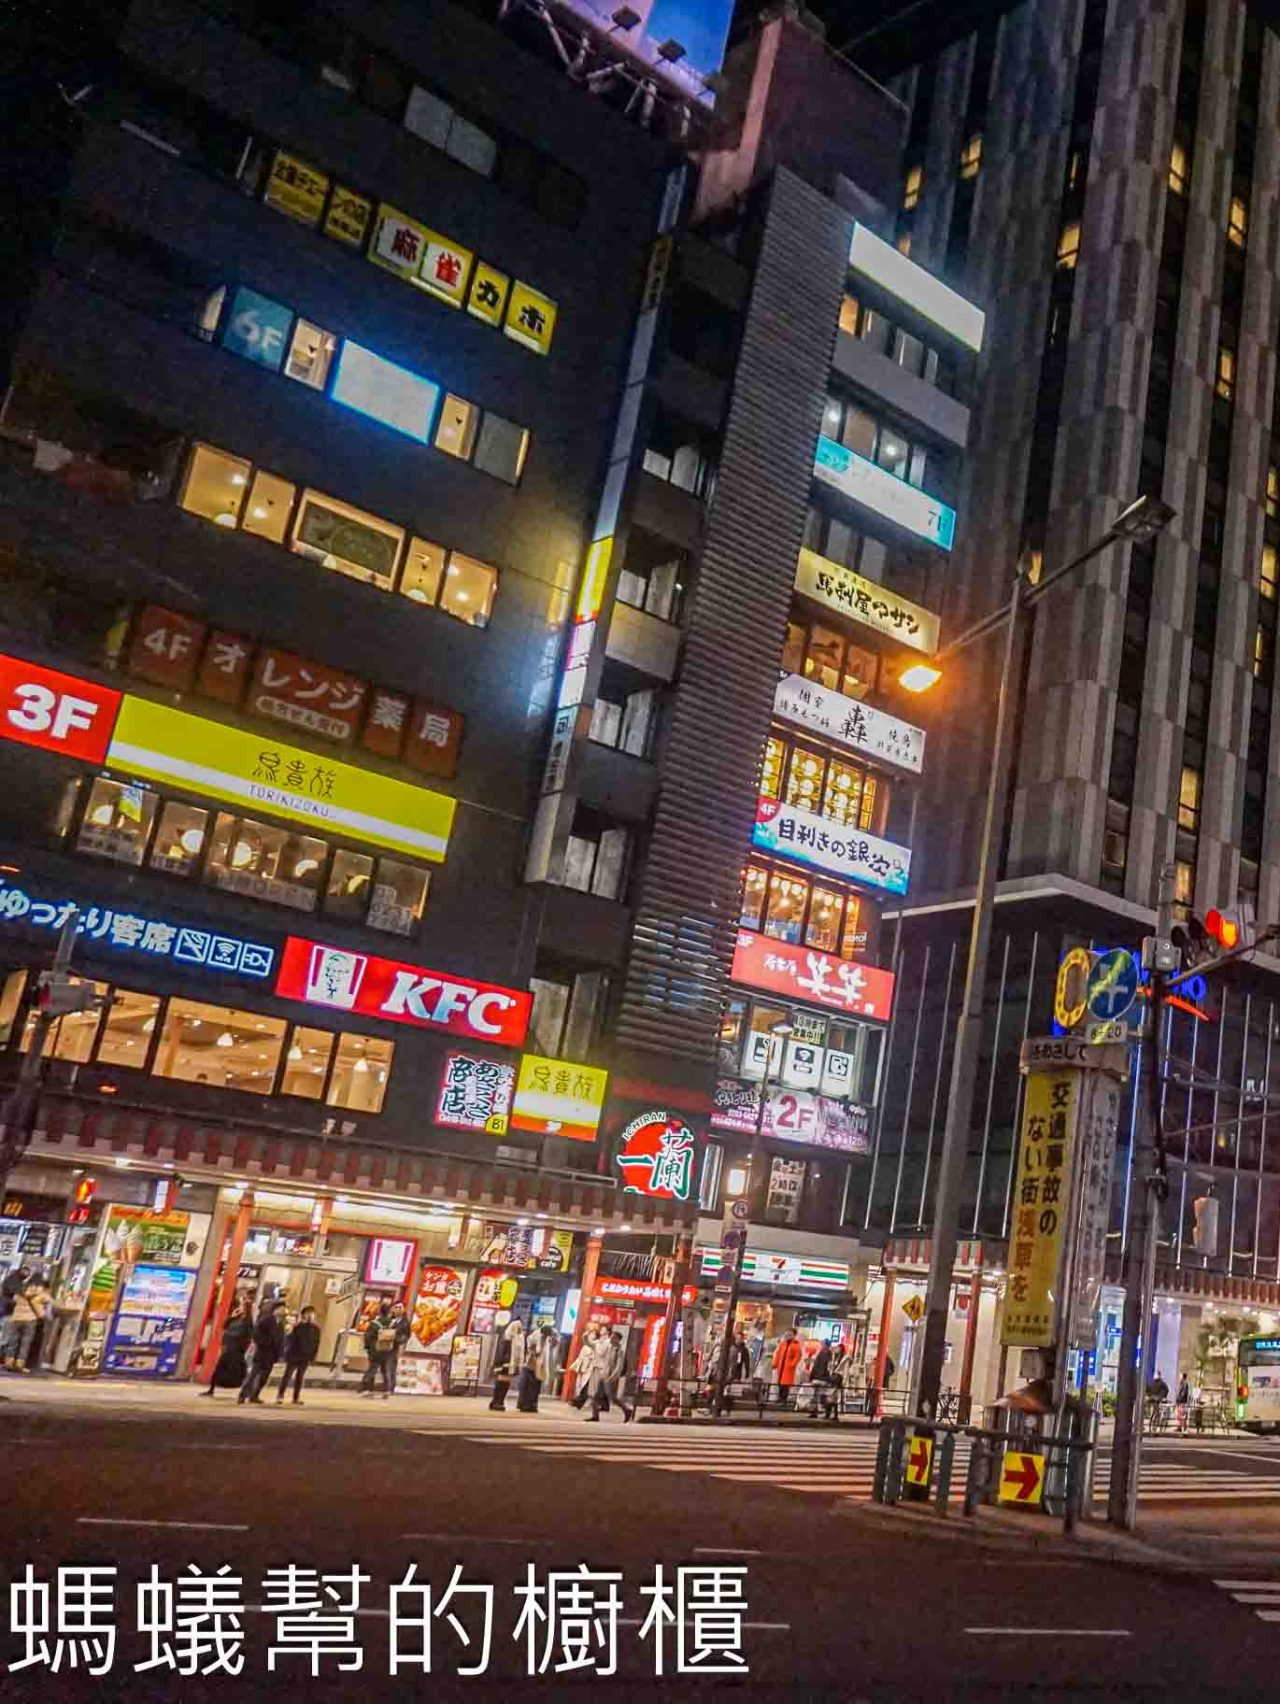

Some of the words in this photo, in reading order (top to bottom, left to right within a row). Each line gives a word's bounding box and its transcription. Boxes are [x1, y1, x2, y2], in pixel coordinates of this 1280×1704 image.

[231, 308, 285, 356] 6F
[143, 628, 192, 660] 4F
[7, 683, 98, 740] 3F
[213, 642, 450, 748] オレンジ薬局
[249, 784, 330, 817] TORIKIZOKU
[759, 802, 776, 816] 4F
[778, 818, 891, 876] 目利きの銀次
[738, 933, 755, 948] 3F
[381, 970, 517, 1035] KFC
[491, 1118, 505, 1130] B1
[622, 1112, 667, 1141] ICHIRAN
[777, 1094, 814, 1129] 2F
[617, 1126, 695, 1200] 一蘭
[1039, 1082, 1072, 1236] 交通事故の
